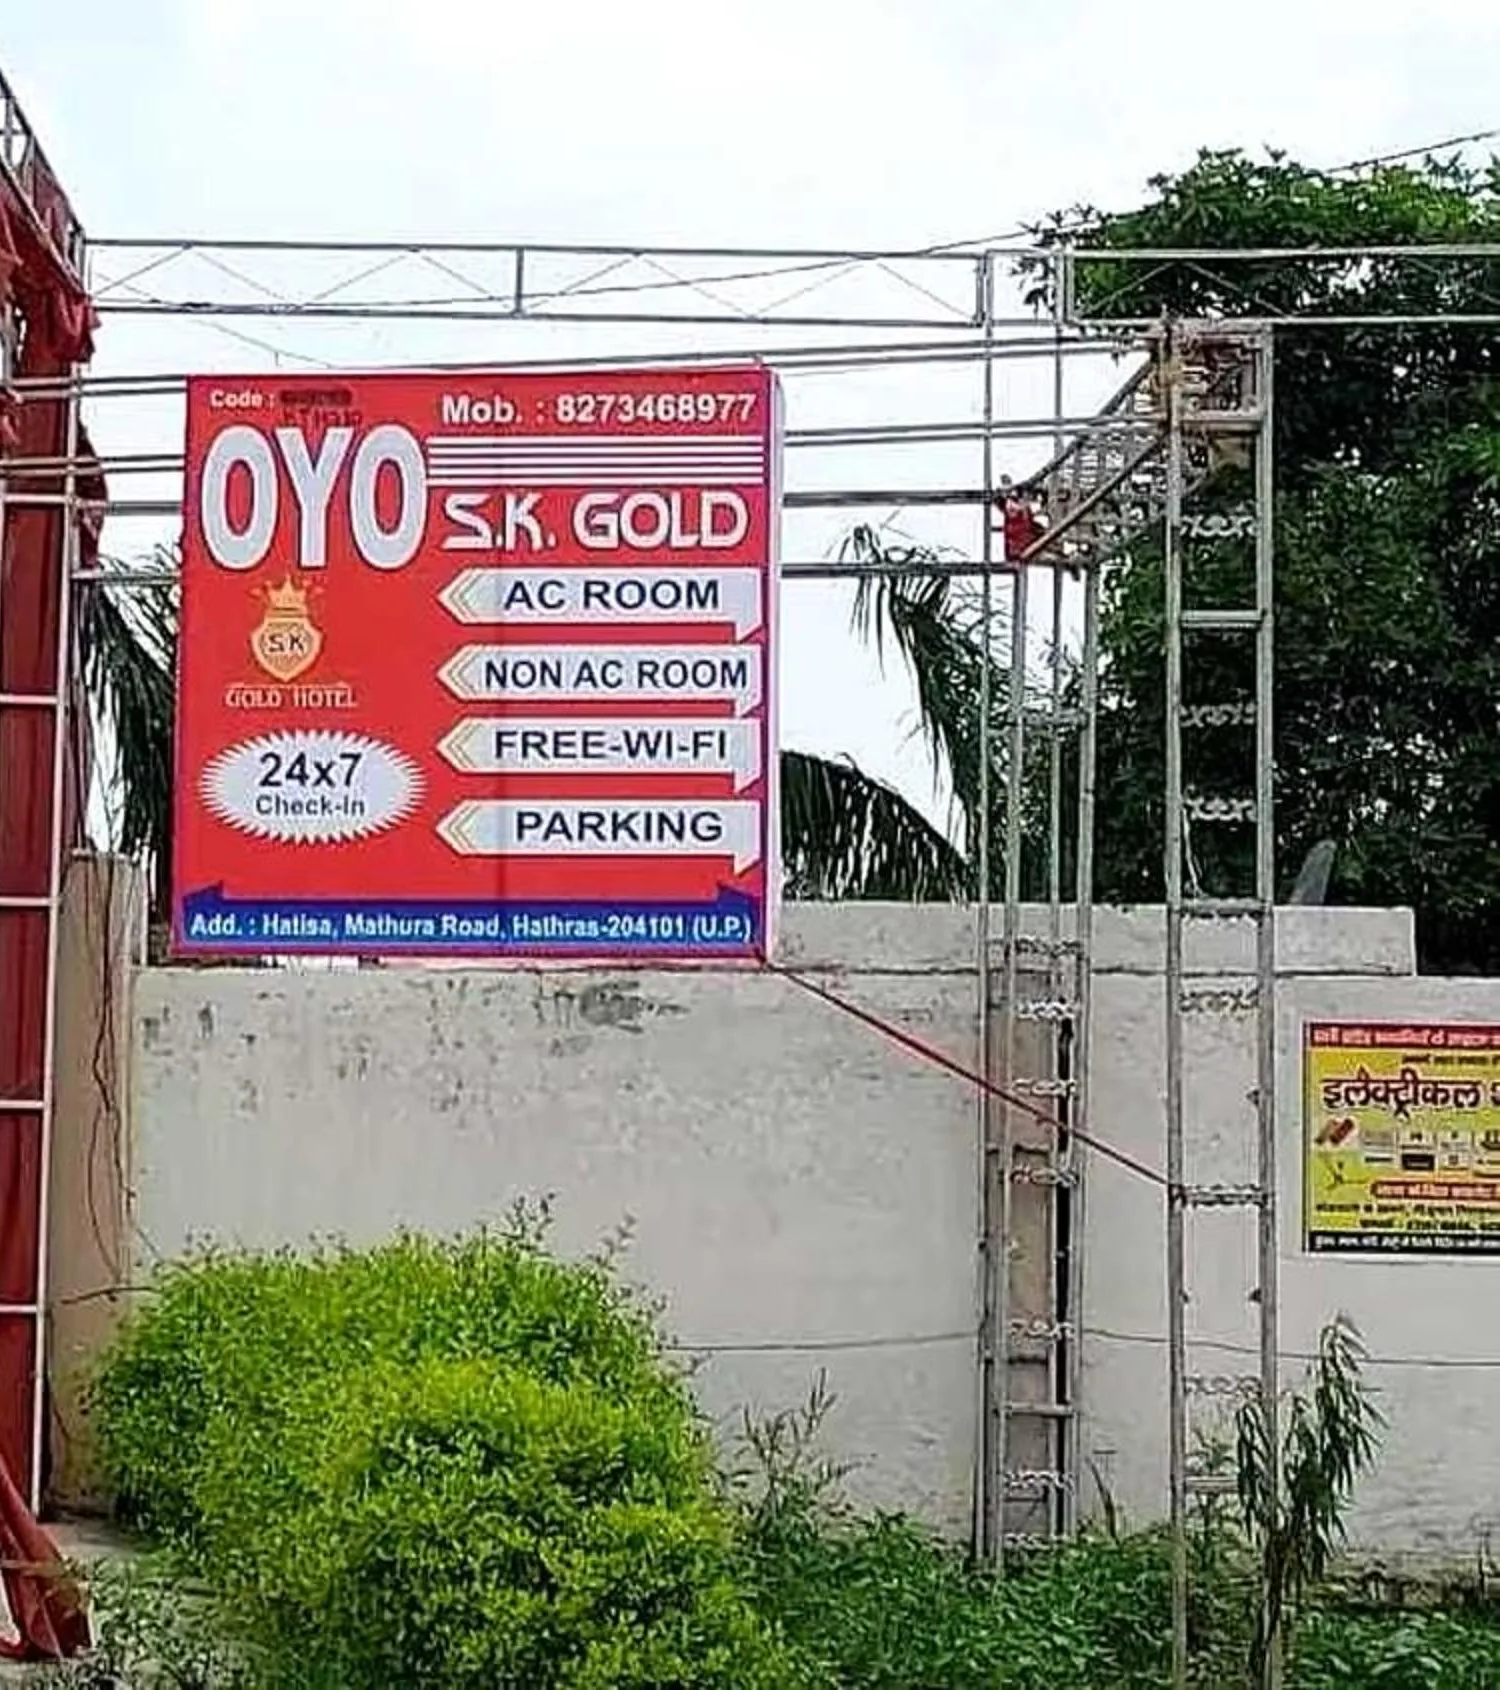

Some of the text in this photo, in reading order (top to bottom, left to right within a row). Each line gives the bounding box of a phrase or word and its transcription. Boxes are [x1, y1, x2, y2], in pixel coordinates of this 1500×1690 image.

[210, 389, 263, 408] Code
[442, 394, 521, 424] Mob.
[556, 393, 756, 422] 8273468977
[201, 424, 427, 571] OYO
[442, 491, 748, 551] S.K. GOLD
[503, 579, 719, 610] AC ROOM
[484, 659, 748, 689] NON AC ROOM
[292, 682, 358, 709] HOTEL
[495, 730, 726, 760] FREE-WI-FI
[259, 754, 362, 787] 24x7
[515, 812, 723, 843] PARKING
[190, 913, 242, 936] Add.
[263, 913, 338, 938] Hatisa,
[345, 914, 435, 936] Mathura
[441, 914, 506, 939] Road,
[513, 914, 684, 939] Hathras-204101
[693, 914, 752, 943] (U.P.)
